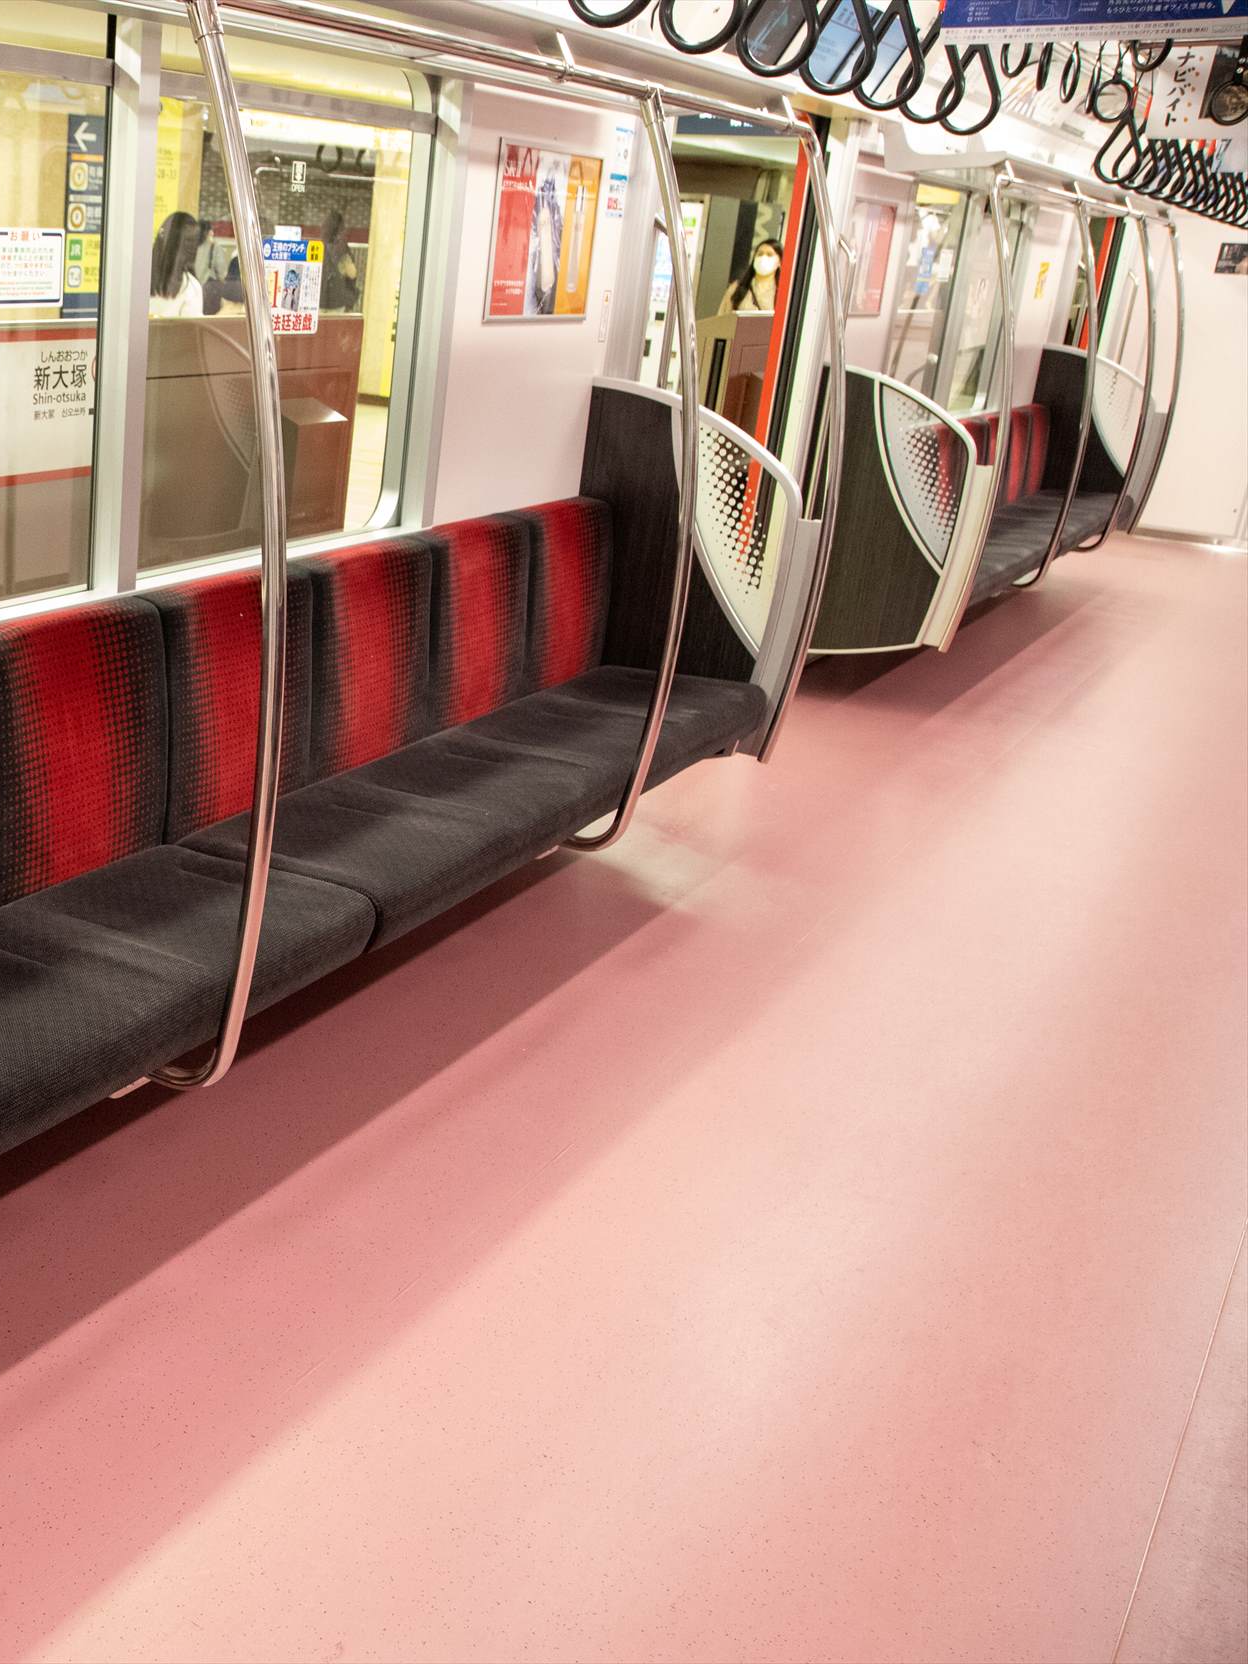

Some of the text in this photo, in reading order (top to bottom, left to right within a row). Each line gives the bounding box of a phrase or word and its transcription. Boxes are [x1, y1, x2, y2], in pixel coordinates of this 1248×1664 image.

[291, 184, 305, 193] OPEN
[9, 231, 41, 241] お願い
[40, 350, 88, 363] しんおおつか
[33, 364, 87, 391] 新大塚
[32, 390, 87, 405] Shin-otsuka
